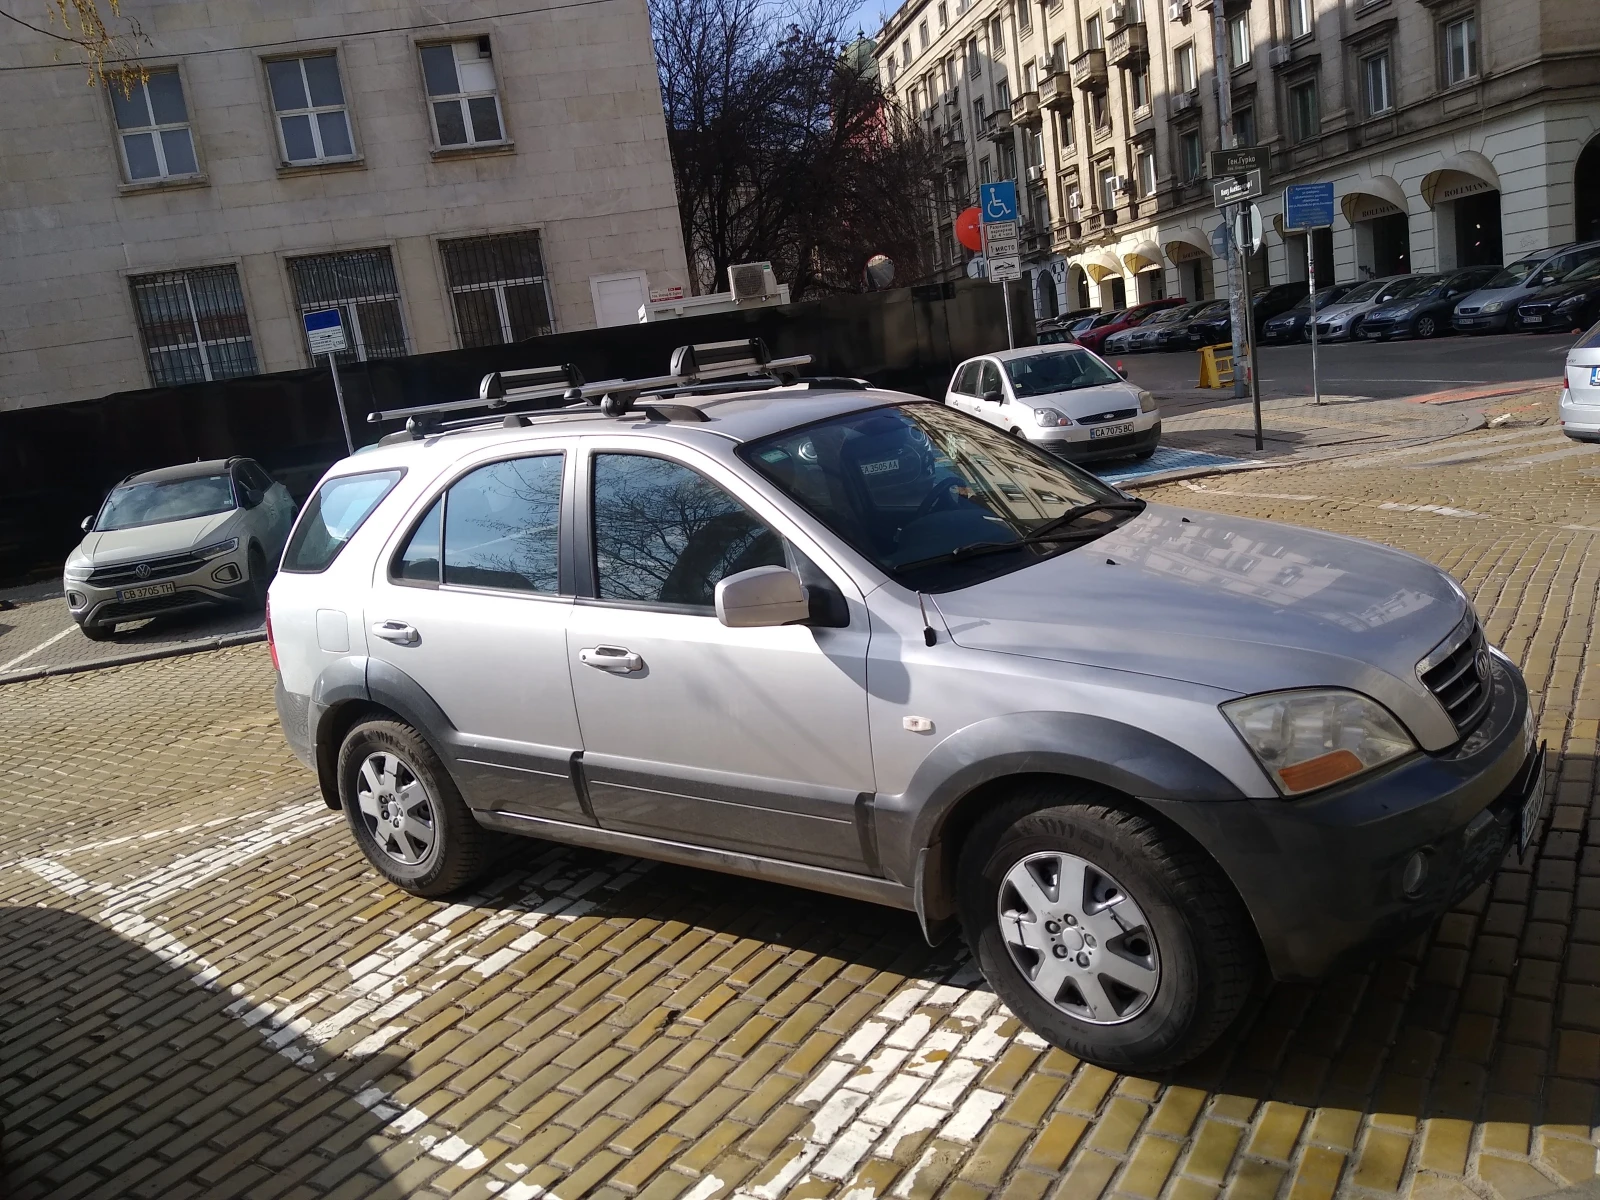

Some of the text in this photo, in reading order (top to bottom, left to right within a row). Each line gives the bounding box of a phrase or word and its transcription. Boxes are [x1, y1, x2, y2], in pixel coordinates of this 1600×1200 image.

[995, 244, 1015, 252] МЯСТО
[1106, 425, 1122, 435] 7075
[123, 583, 174, 600] CB 3705 TH
